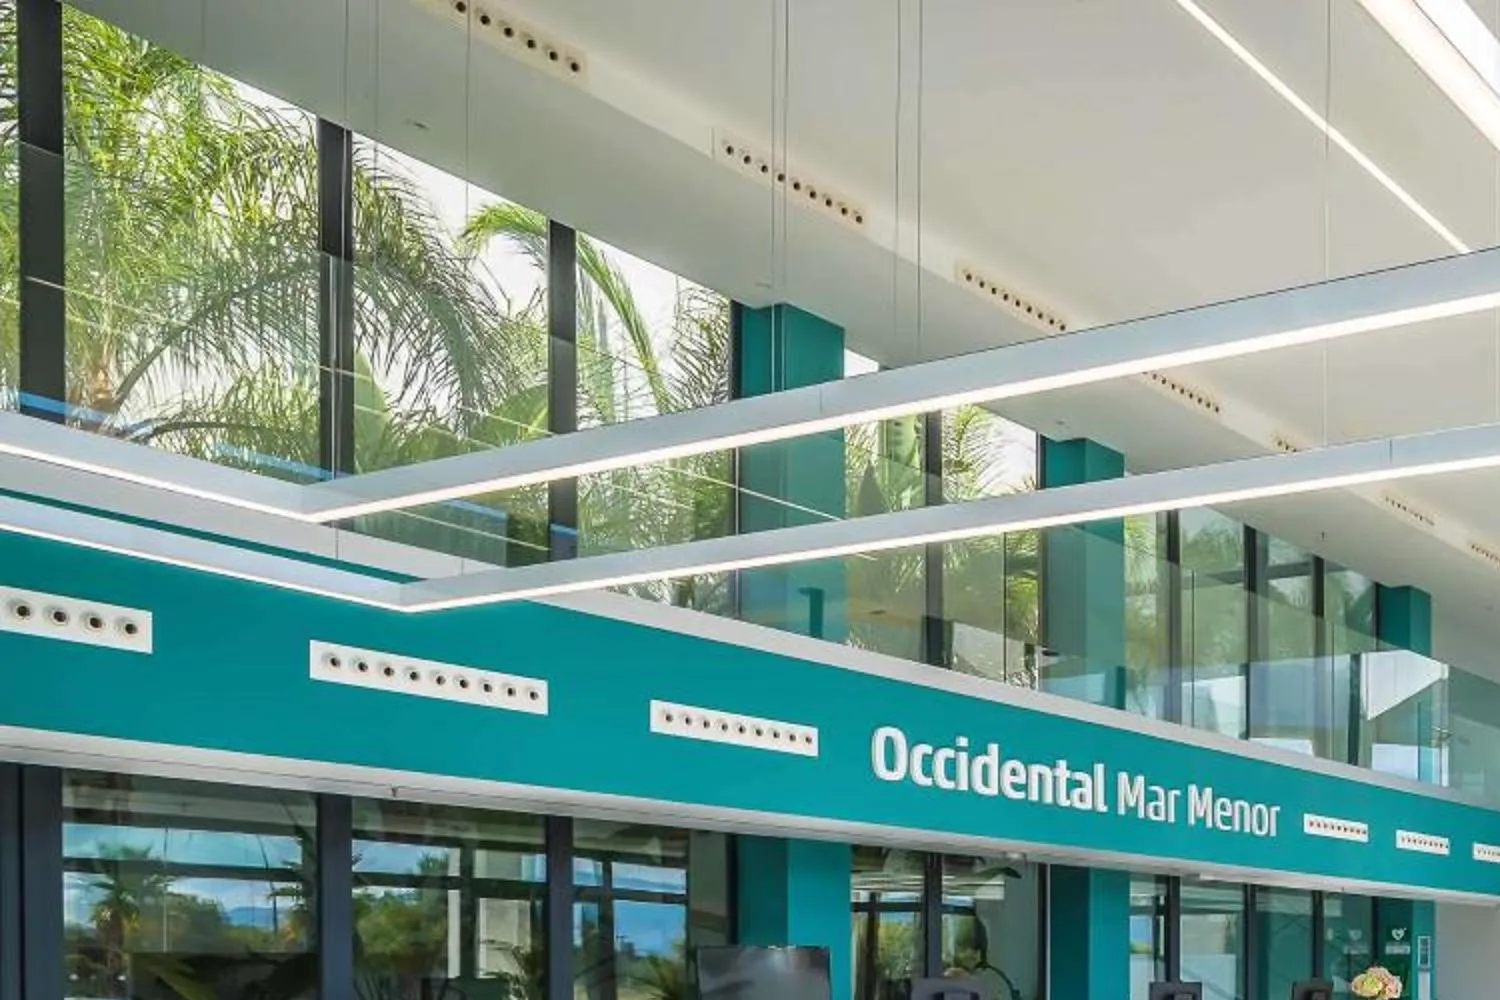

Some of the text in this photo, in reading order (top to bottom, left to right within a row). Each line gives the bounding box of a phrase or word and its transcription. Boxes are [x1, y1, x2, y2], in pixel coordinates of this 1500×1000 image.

[871, 726, 1281, 837] Occidental Mar Menor
